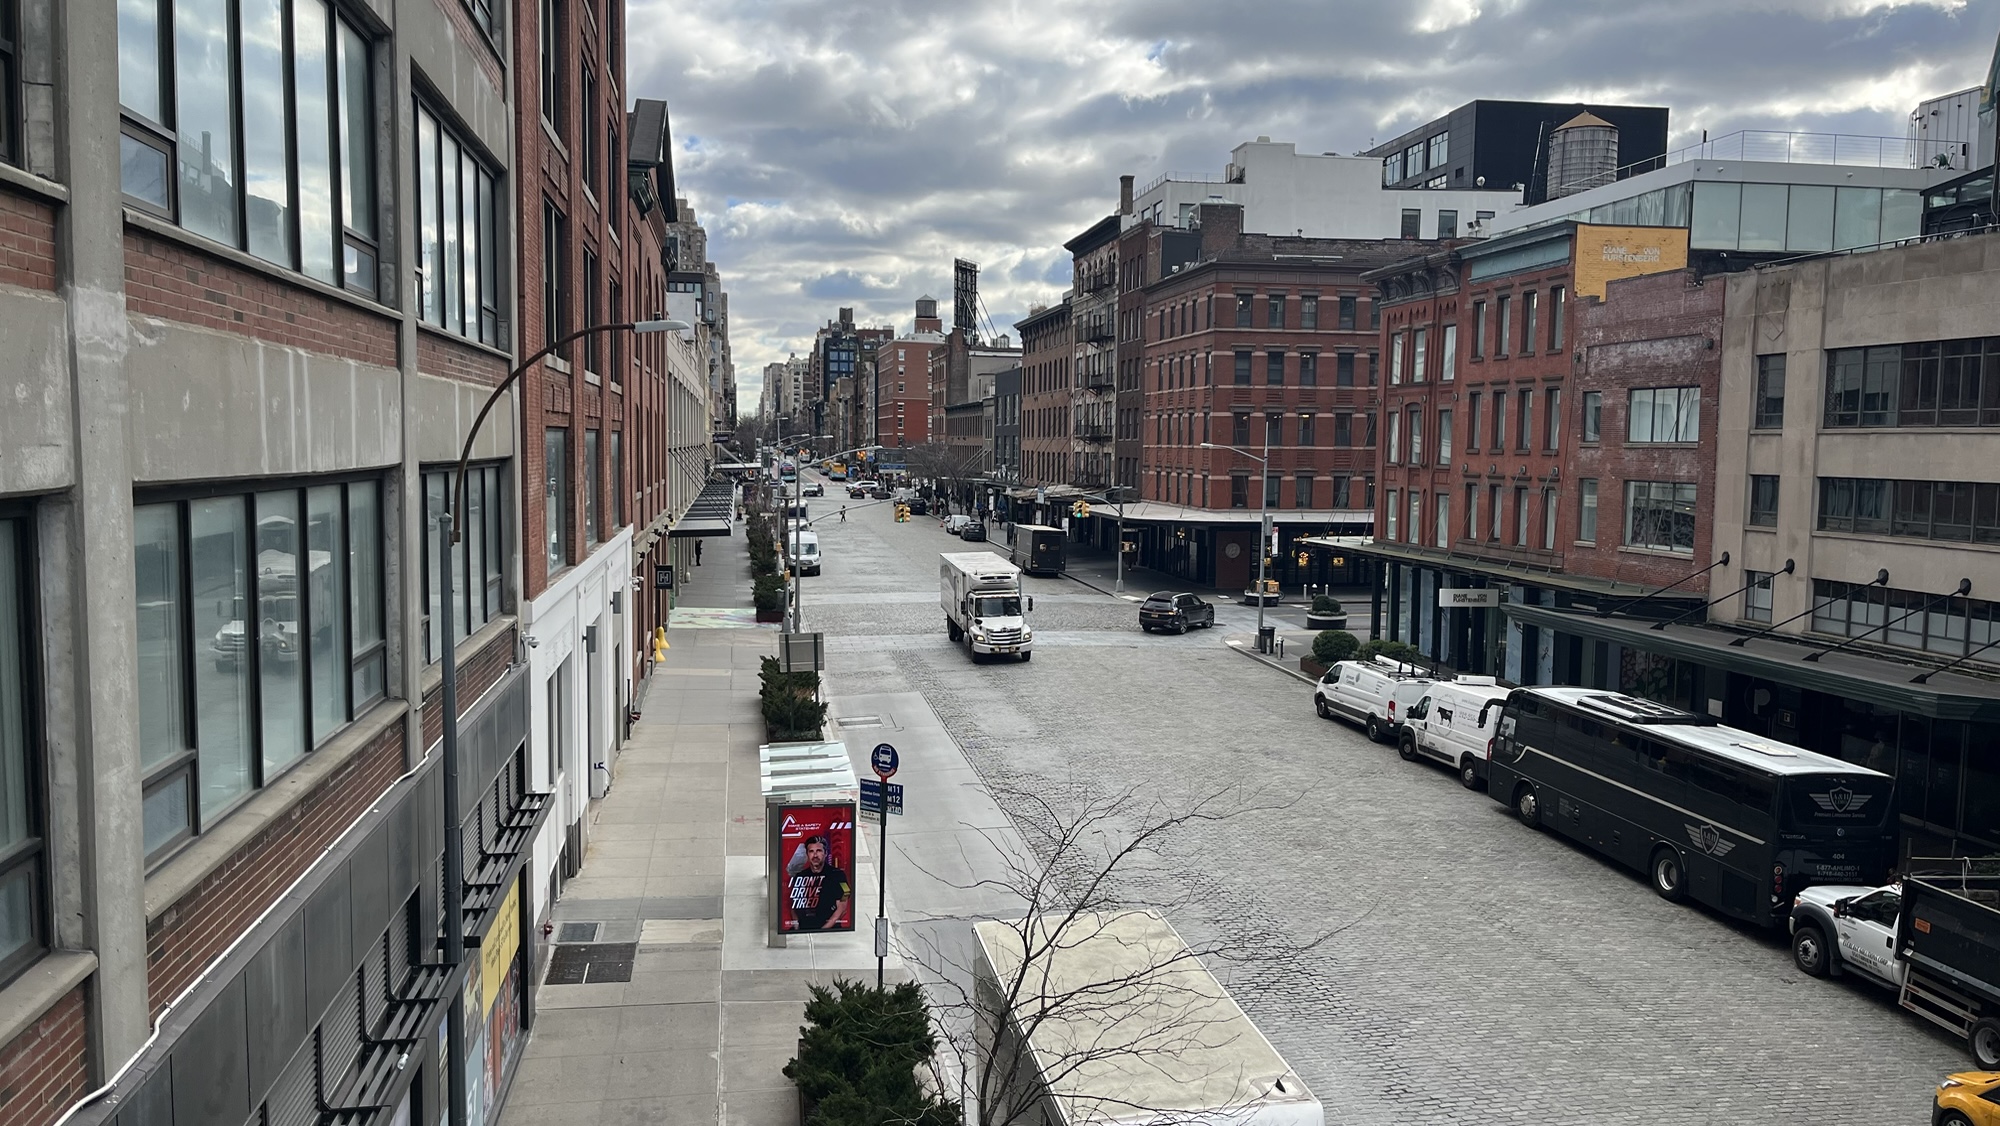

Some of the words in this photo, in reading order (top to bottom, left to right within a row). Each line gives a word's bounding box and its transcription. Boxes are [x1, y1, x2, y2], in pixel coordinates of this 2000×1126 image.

[1603, 246, 1626, 254] DIANE
[1643, 246, 1660, 255] VON
[1602, 254, 1660, 262] FURSTENBERG
[888, 785, 900, 794] M11
[887, 796, 900, 804] M12
[788, 876, 794, 888] I
[794, 876, 826, 888] DON'T
[790, 886, 822, 898] DRIVE
[792, 898, 819, 909] TIRED
